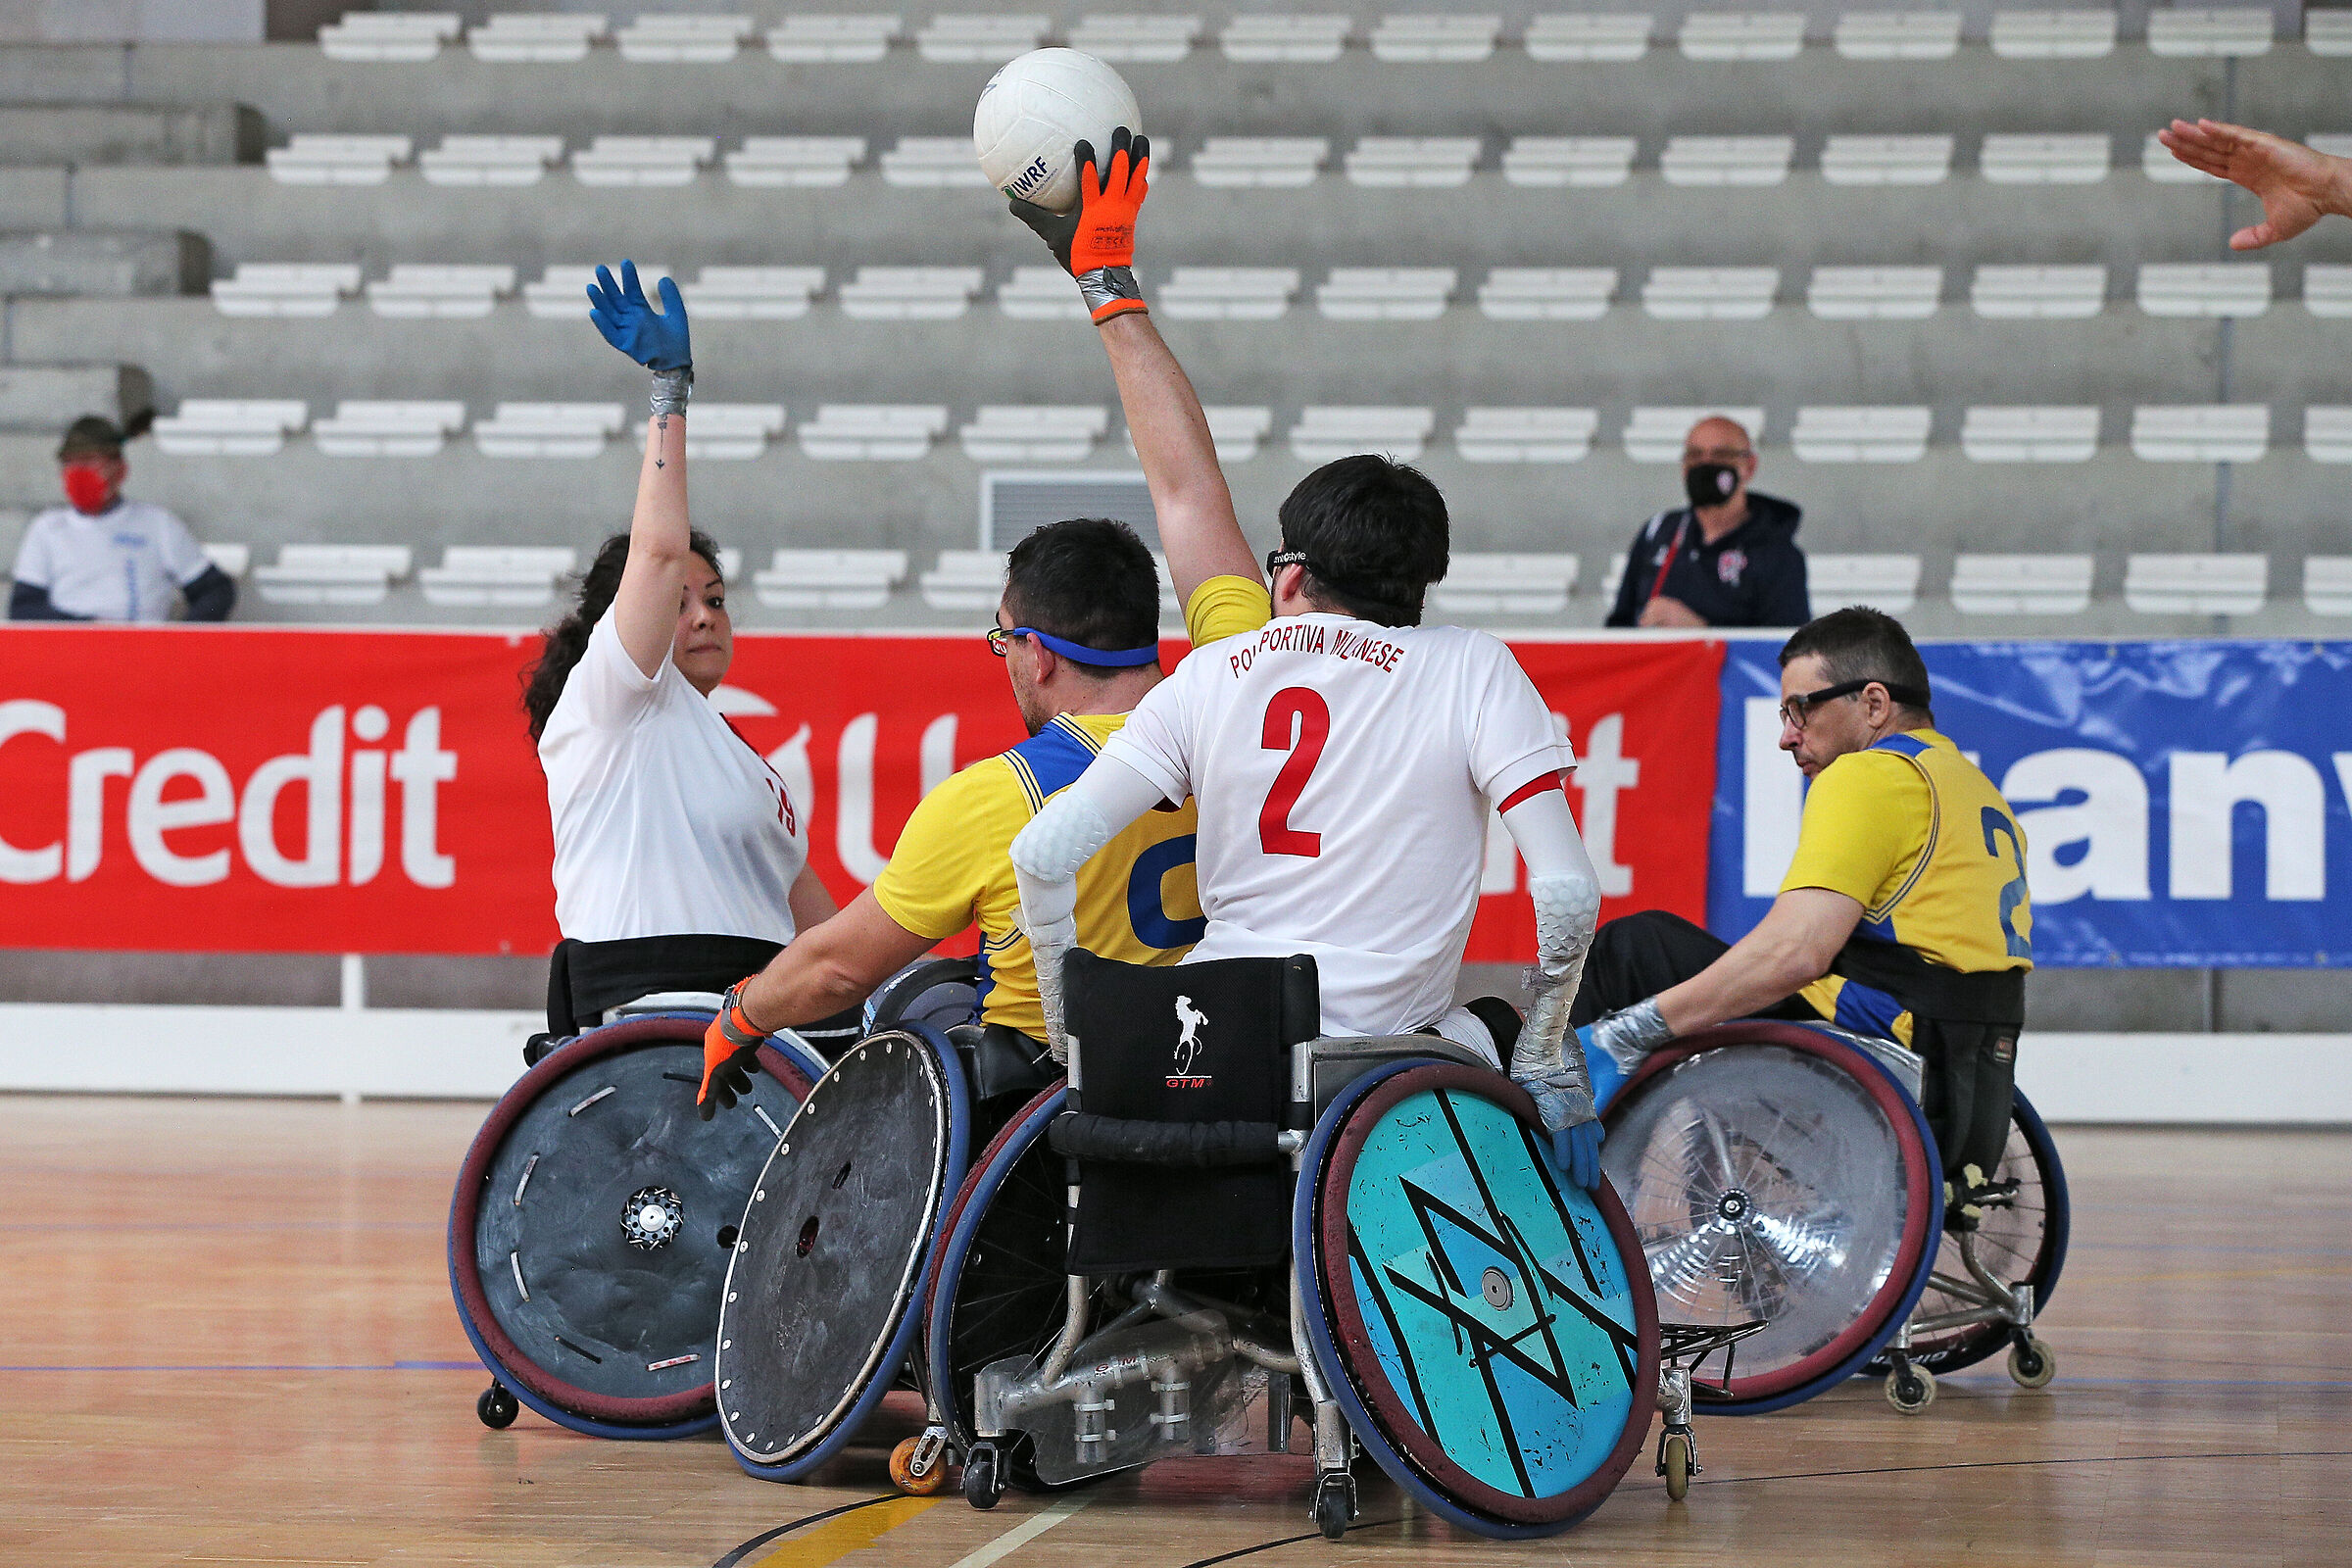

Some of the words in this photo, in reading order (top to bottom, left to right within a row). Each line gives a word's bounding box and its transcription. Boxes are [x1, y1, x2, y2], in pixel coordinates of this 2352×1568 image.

[1010, 155, 1048, 197] IWRF
[1258, 686, 1331, 858] 2
[1165, 1078, 1205, 1089] GTM
